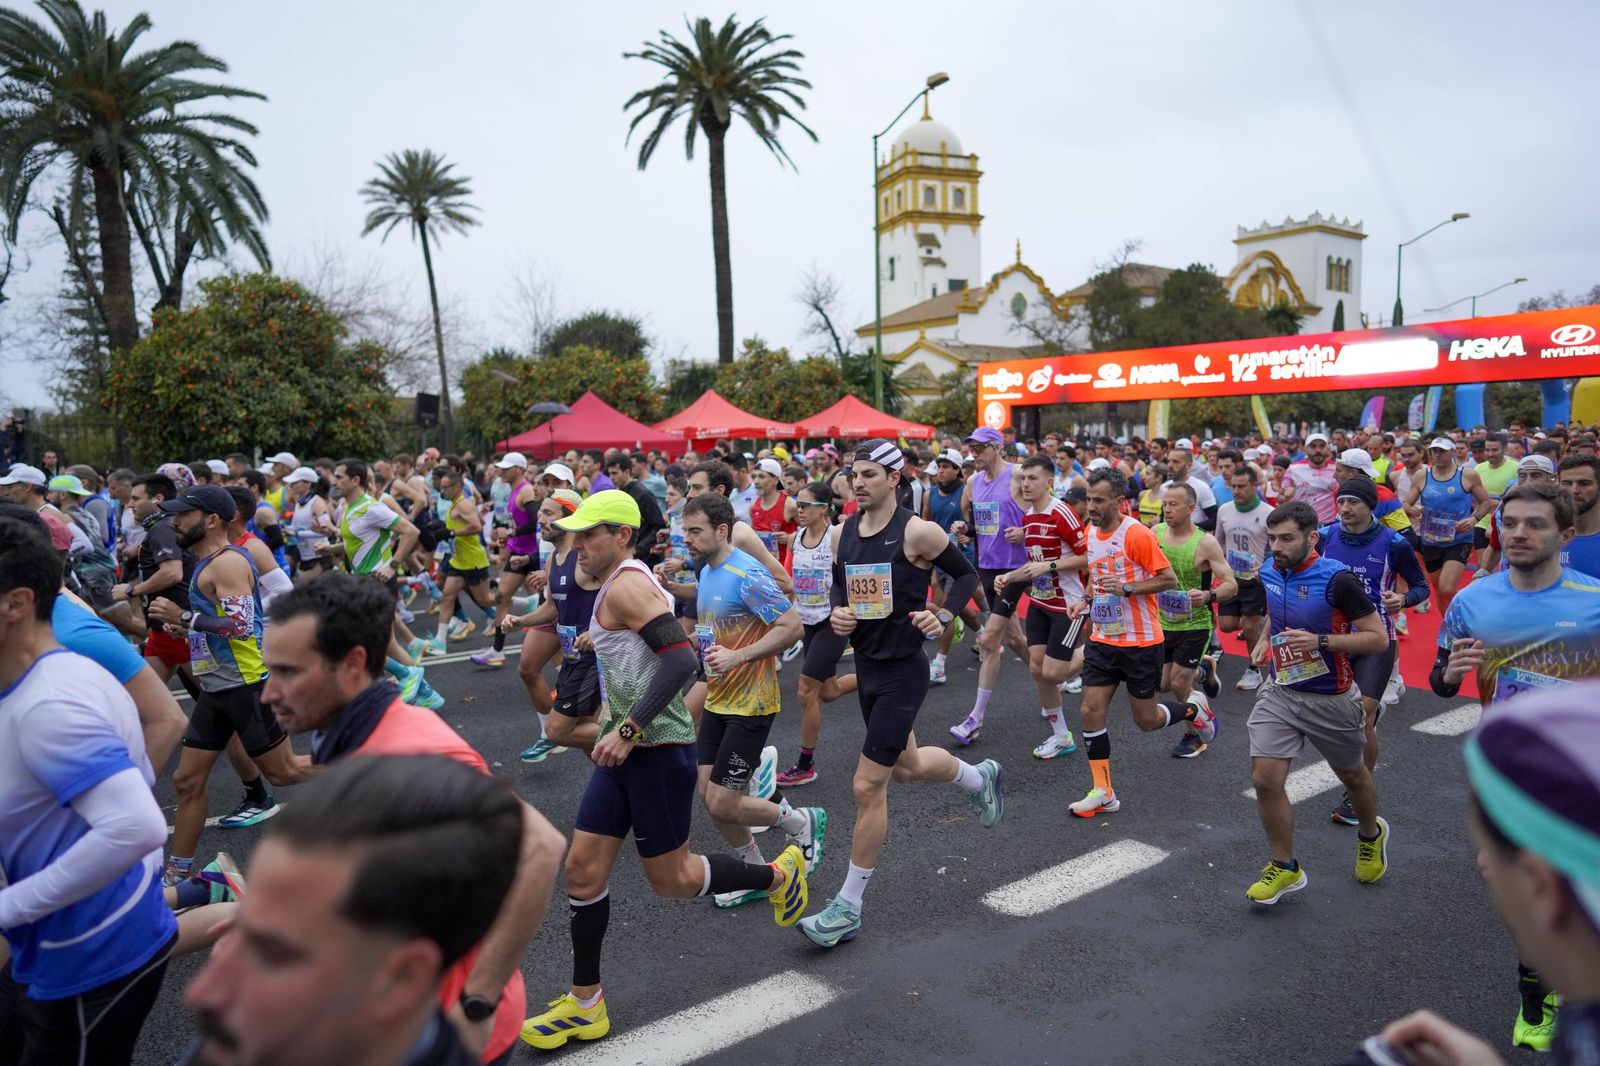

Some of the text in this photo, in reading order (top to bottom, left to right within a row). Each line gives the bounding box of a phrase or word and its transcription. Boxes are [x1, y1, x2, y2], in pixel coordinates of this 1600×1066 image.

[1250, 344, 1335, 366] maratón
[1448, 335, 1527, 361] HOKA
[1541, 345, 1600, 358] HYUNDA
[1130, 363, 1180, 384] HOKA
[1270, 361, 1335, 380] sevilla
[976, 511, 991, 521] 2708
[1233, 534, 1248, 551] 46
[851, 578, 877, 595] 4333
[1161, 595, 1182, 609] 2822
